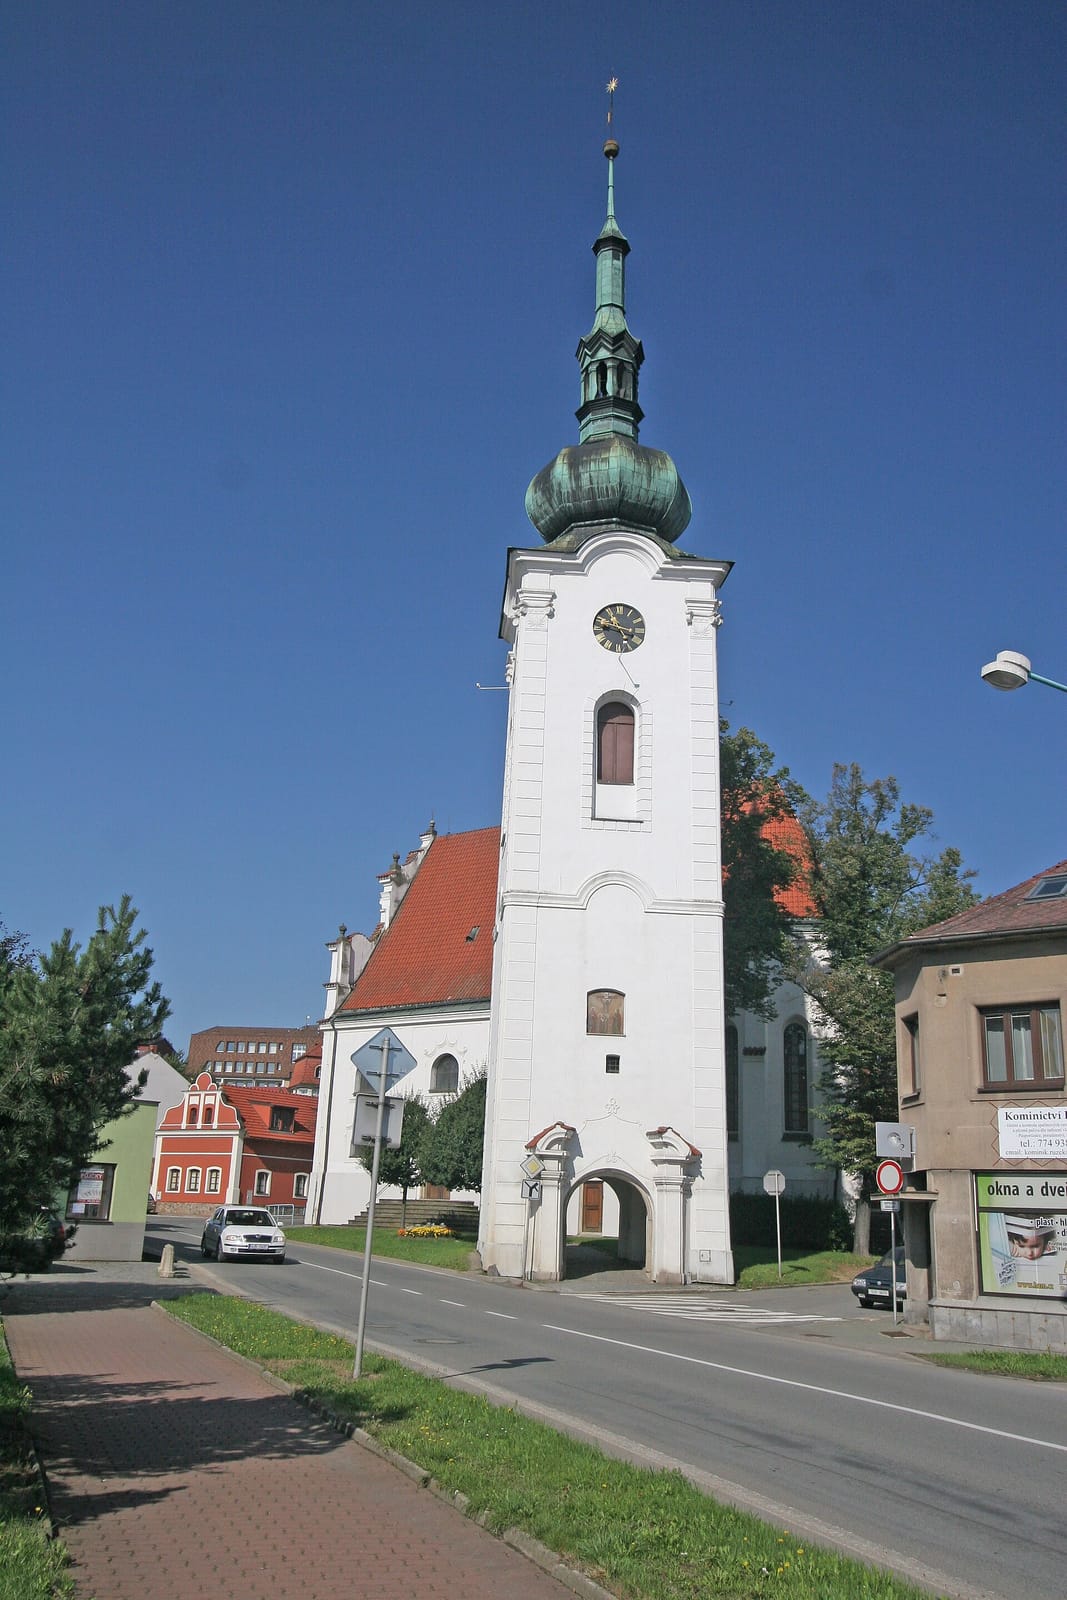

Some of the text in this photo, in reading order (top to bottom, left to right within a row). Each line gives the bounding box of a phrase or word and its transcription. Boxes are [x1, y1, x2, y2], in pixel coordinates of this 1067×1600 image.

[1005, 1111, 1061, 1121] Kominictví
[1038, 1139, 1053, 1148] 774
[987, 1181, 1067, 1197] okna a dve
[1036, 1217, 1054, 1228] plast
